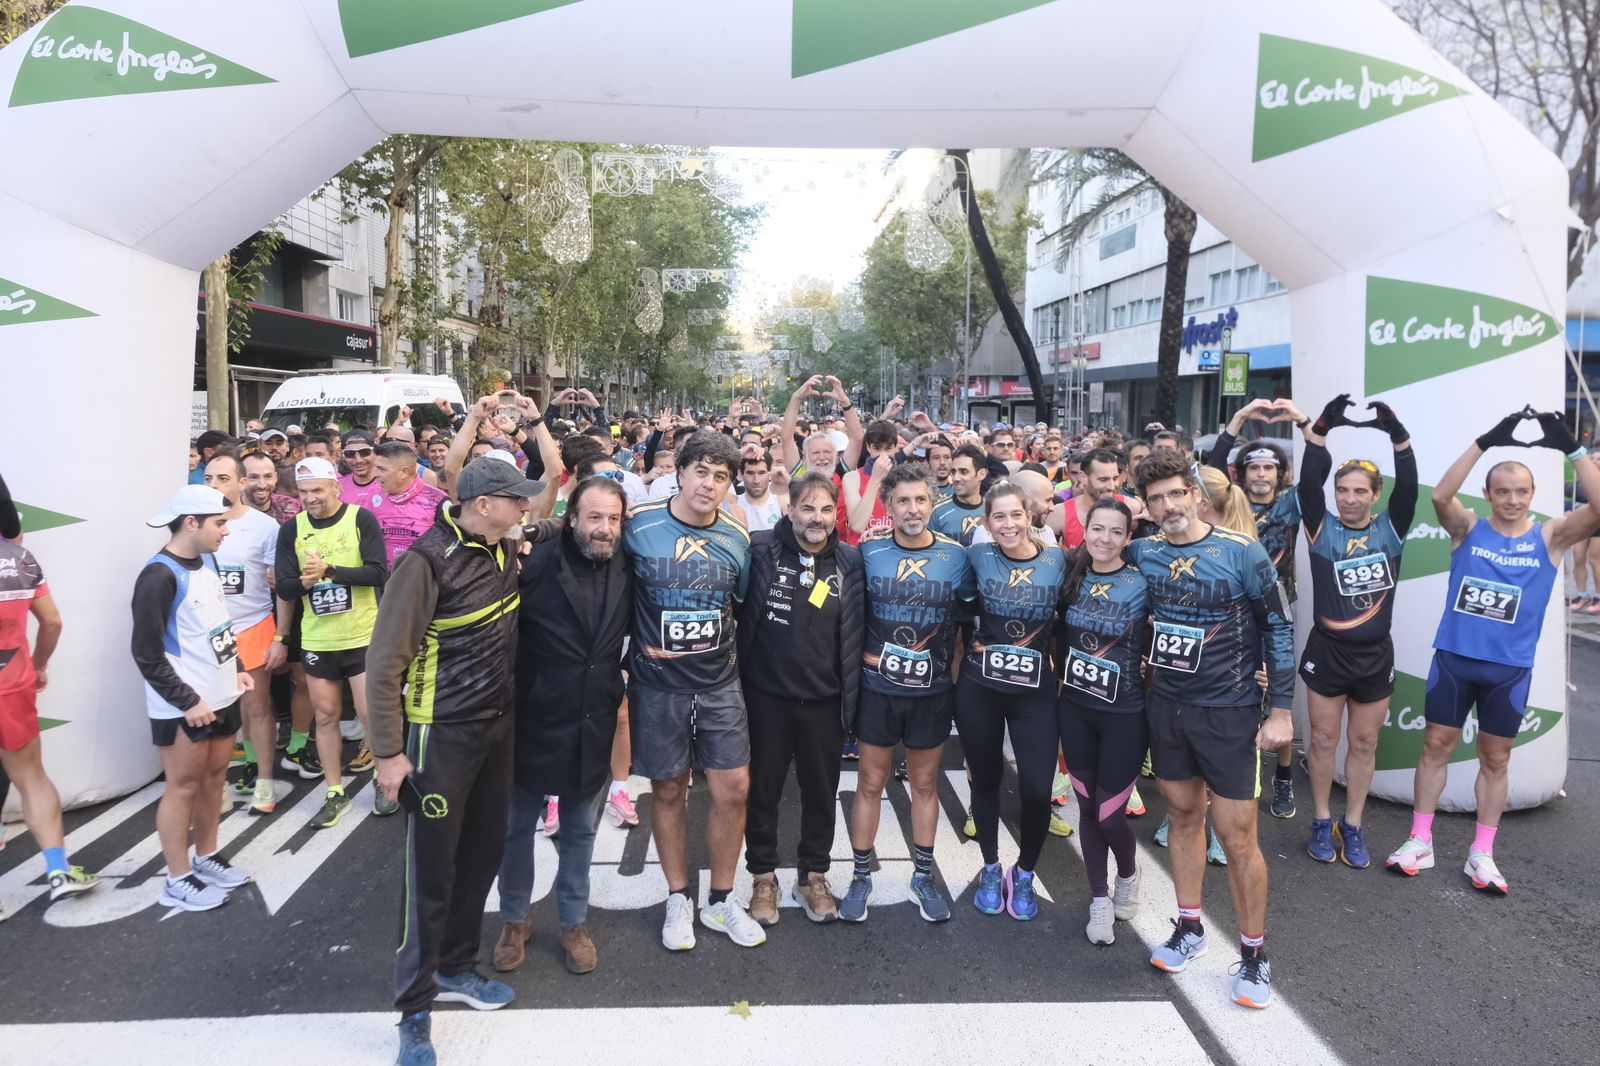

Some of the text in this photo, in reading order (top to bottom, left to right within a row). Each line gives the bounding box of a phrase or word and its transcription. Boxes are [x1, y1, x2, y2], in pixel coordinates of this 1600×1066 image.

[31, 31, 217, 81] El Corte Inglés
[1260, 65, 1439, 110] El Corte Inglés
[1369, 305, 1546, 349] El Corte Inglés
[346, 333, 368, 350] cajasur
[1225, 382, 1244, 392] BUS
[1204, 545, 1222, 559] SIG
[1471, 546, 1540, 568] TROTASIERRA
[219, 571, 241, 586] 56
[1343, 562, 1385, 585] 393
[312, 587, 348, 605] 548
[1464, 586, 1514, 610] 367
[669, 620, 716, 640] 624
[1157, 633, 1196, 657] 627
[886, 655, 929, 676] 619
[990, 651, 1035, 673] 625
[1072, 659, 1110, 687] 631
[413, 682, 425, 708] AMIGOS
